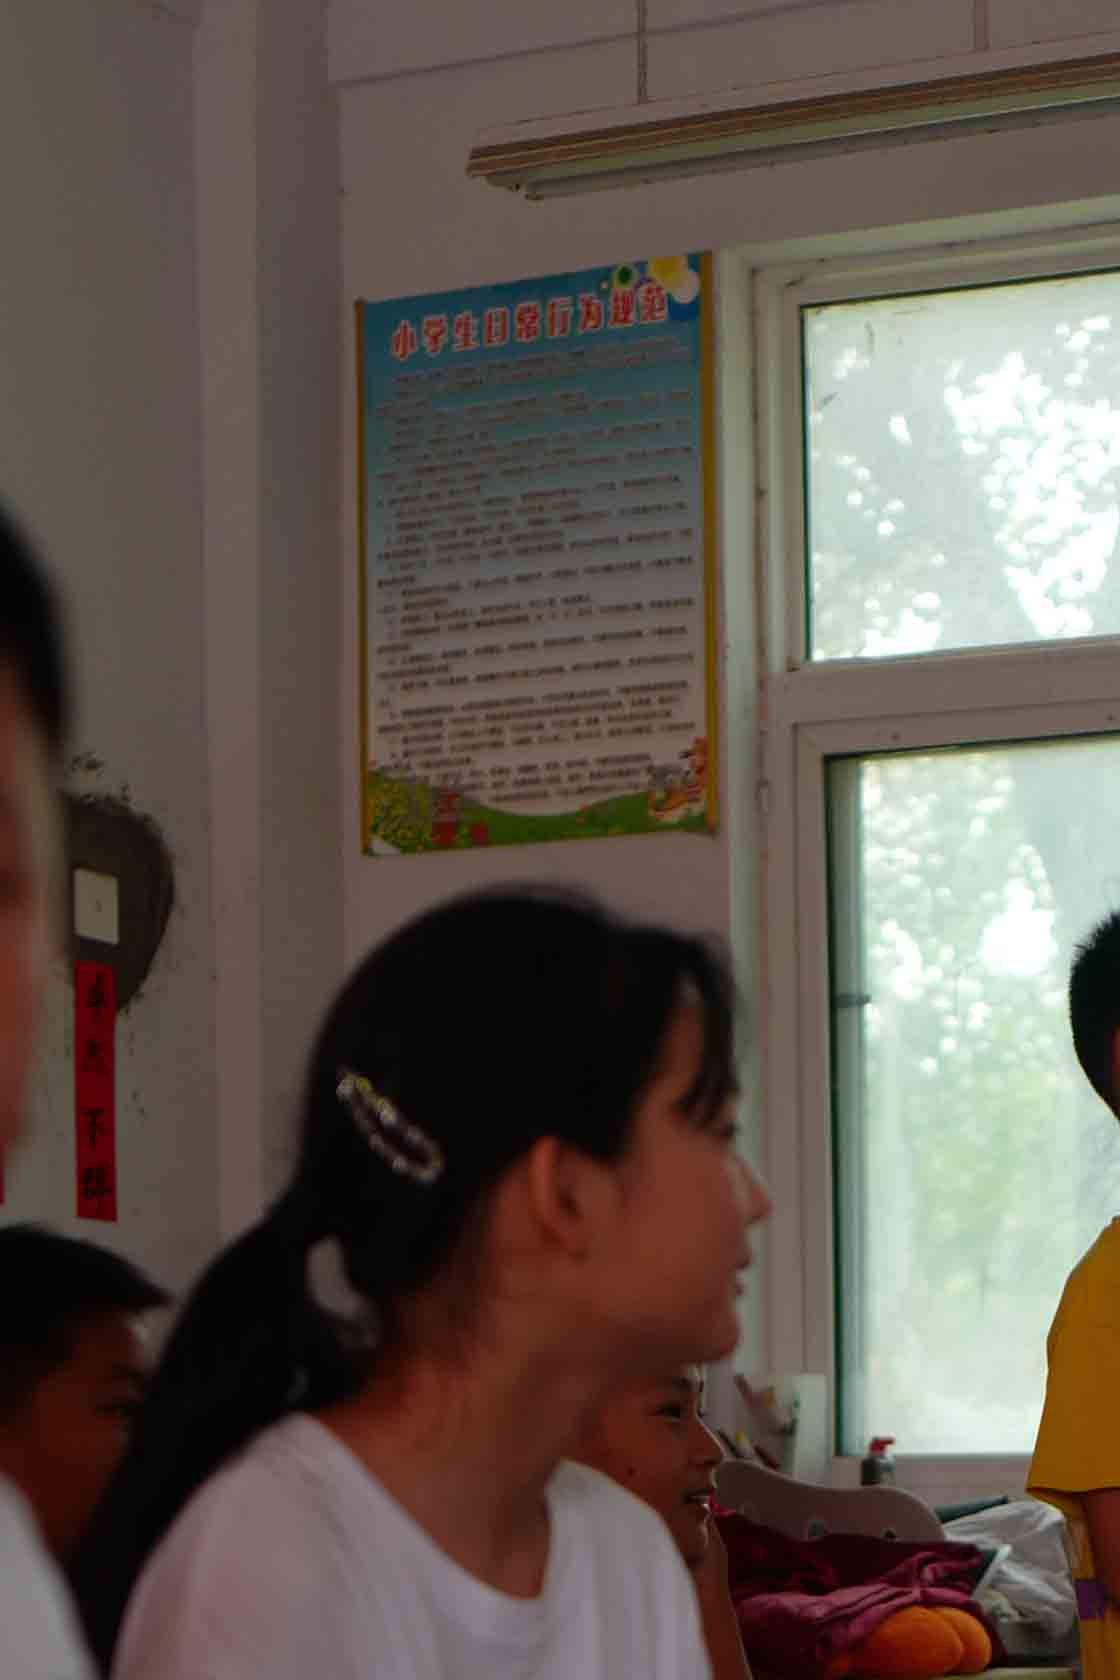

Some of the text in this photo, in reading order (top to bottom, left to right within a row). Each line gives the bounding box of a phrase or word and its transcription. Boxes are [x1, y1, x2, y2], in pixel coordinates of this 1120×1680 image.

[391, 284, 668, 361] 小学生日常行为规范
